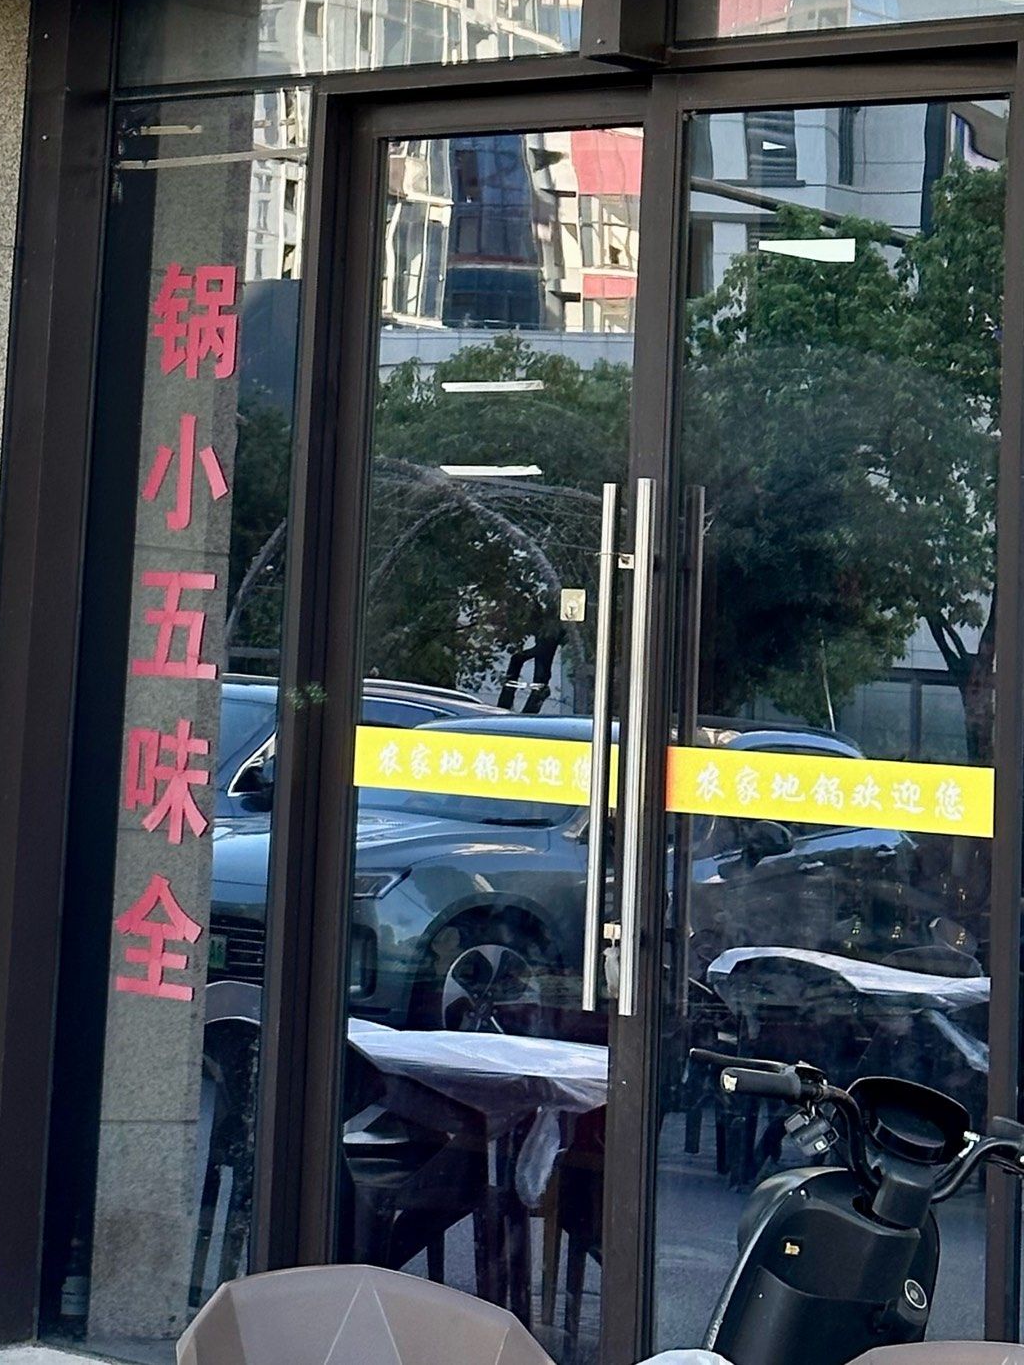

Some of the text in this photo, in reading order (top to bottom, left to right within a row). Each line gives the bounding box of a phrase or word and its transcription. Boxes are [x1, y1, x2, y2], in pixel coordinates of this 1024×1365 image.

[114, 262, 239, 1003] 锅小五味全
[695, 761, 965, 822] 农家地锅欢迎您
